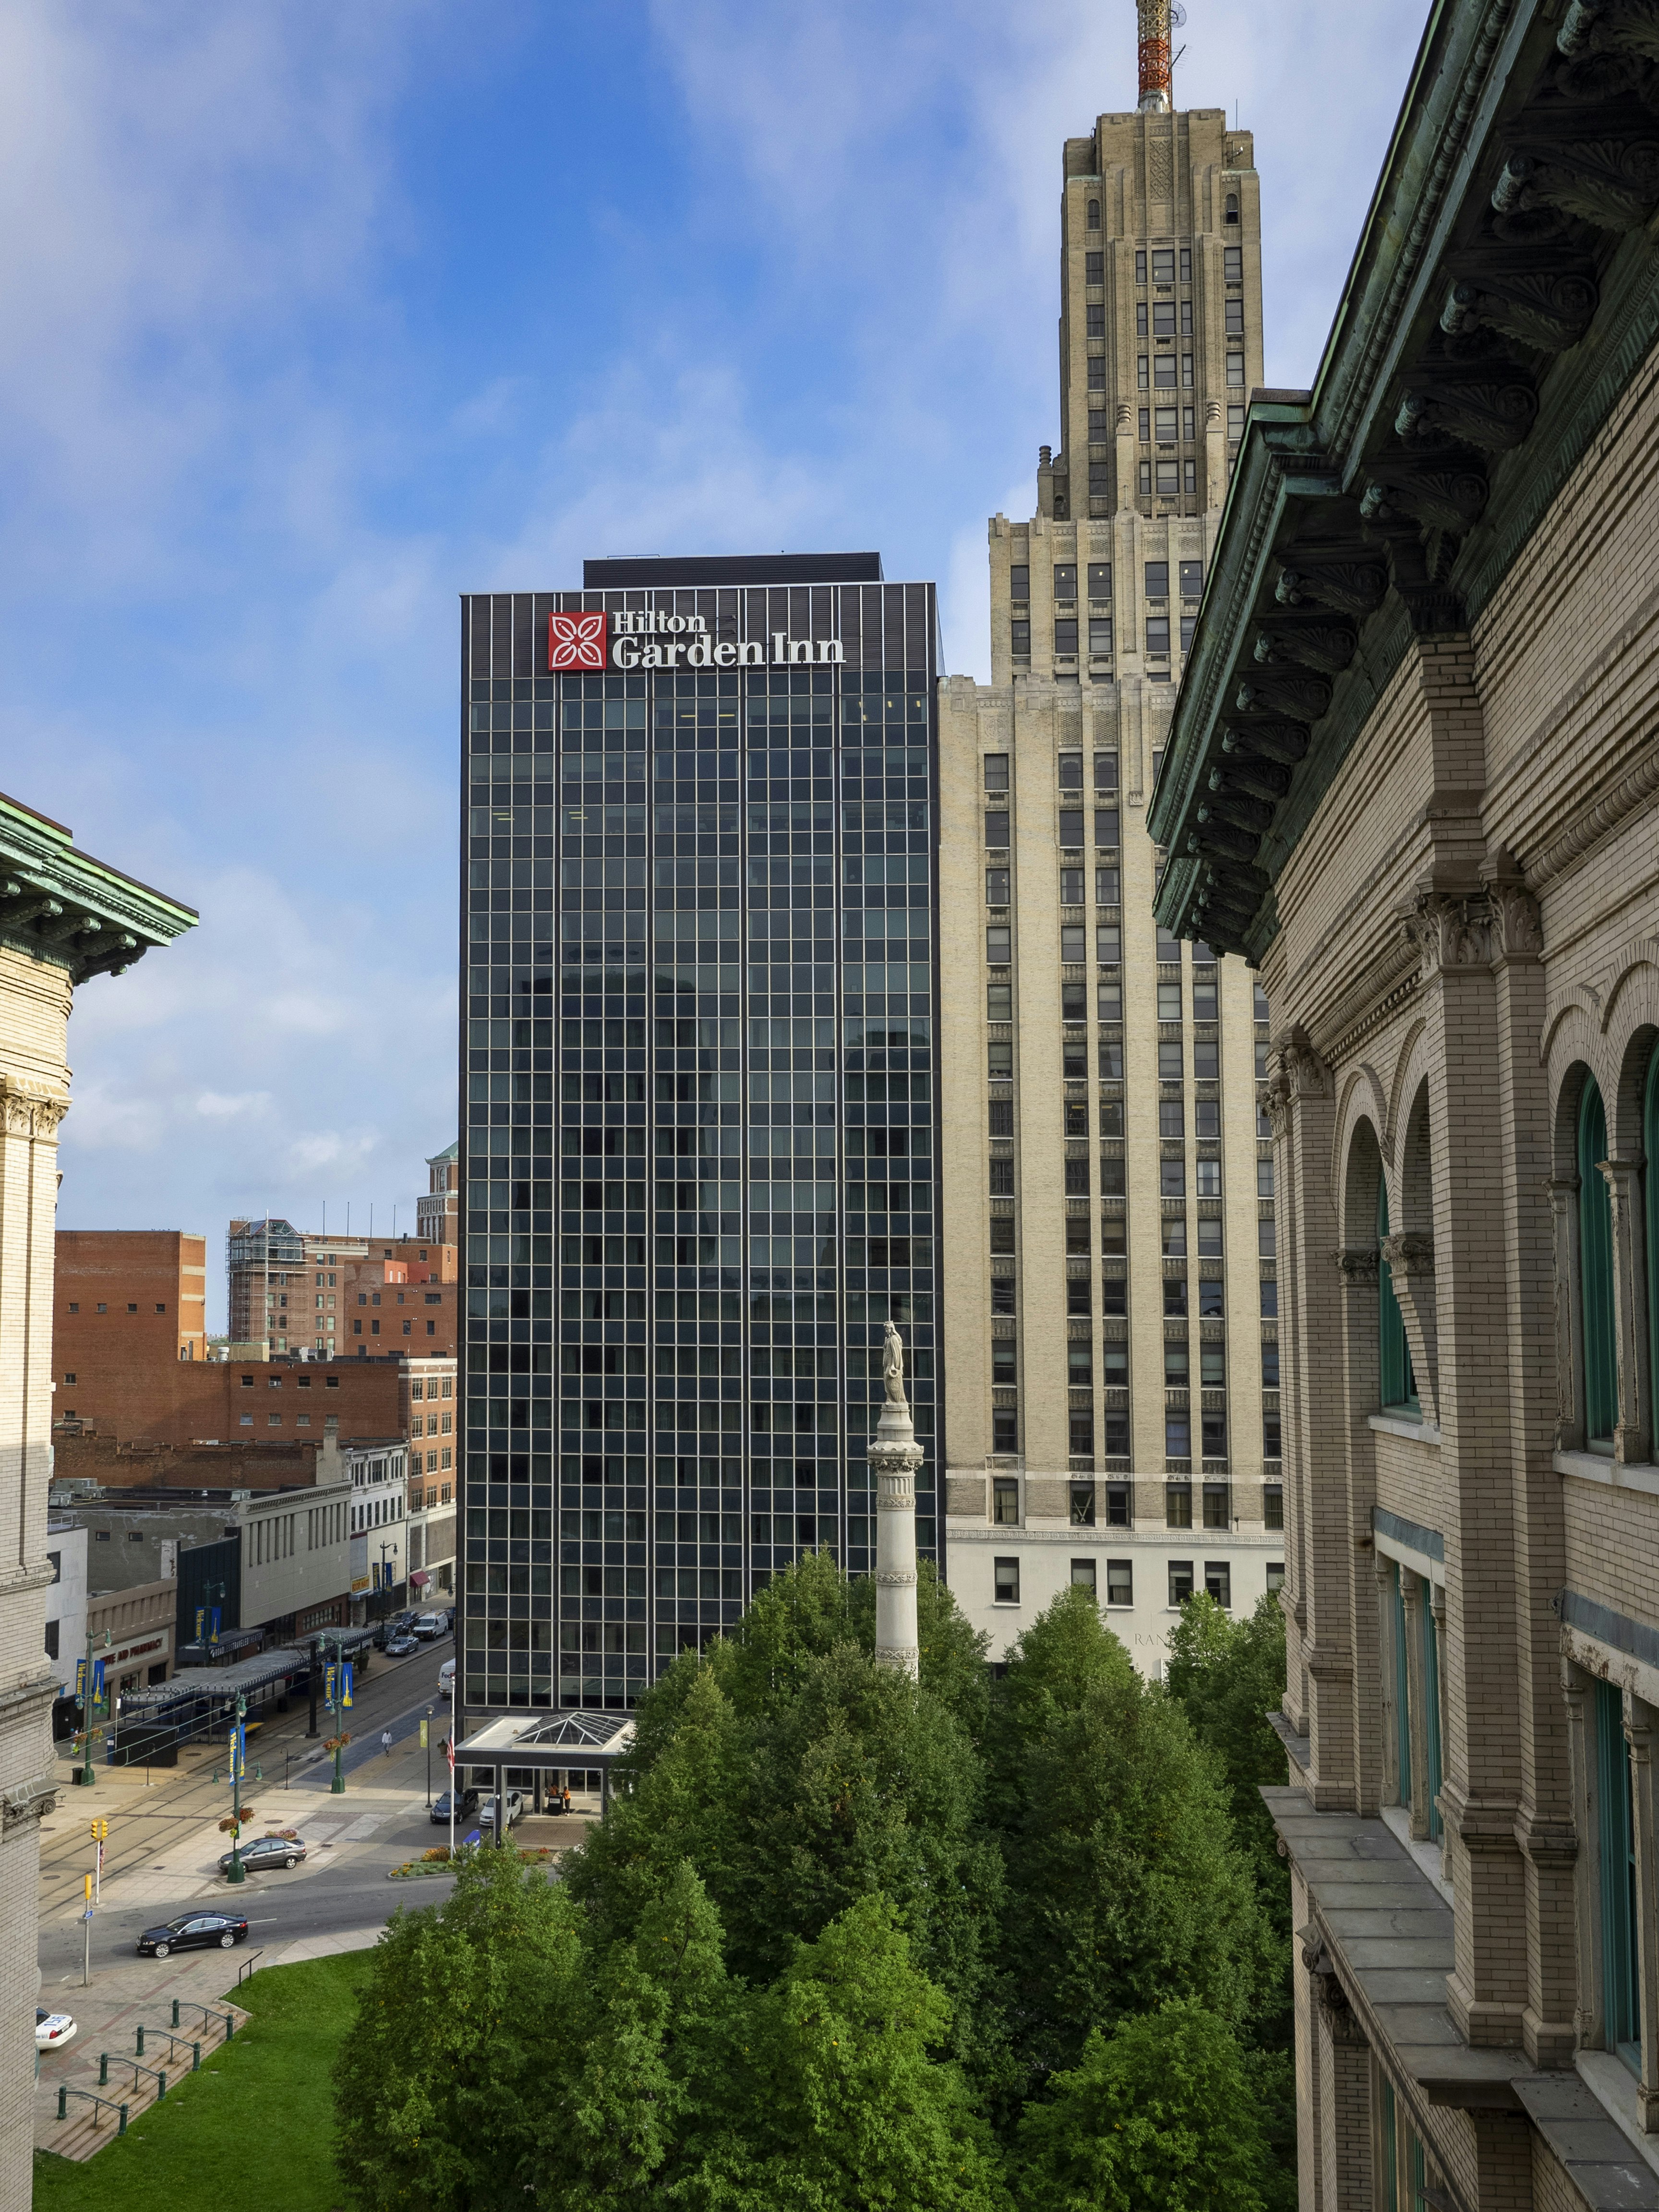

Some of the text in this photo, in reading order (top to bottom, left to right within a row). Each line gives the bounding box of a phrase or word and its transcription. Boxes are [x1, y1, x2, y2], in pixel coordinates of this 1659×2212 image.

[613, 610, 708, 634] Hilton
[613, 632, 847, 669] Garden Inn
[196, 1610, 204, 1638] Welcome
[100, 1637, 164, 1667] ITE AID PHARMACY
[1134, 1633, 1168, 1646] RAN
[326, 1666, 335, 1700] Welcome
[44, 2016, 67, 2026] 156
